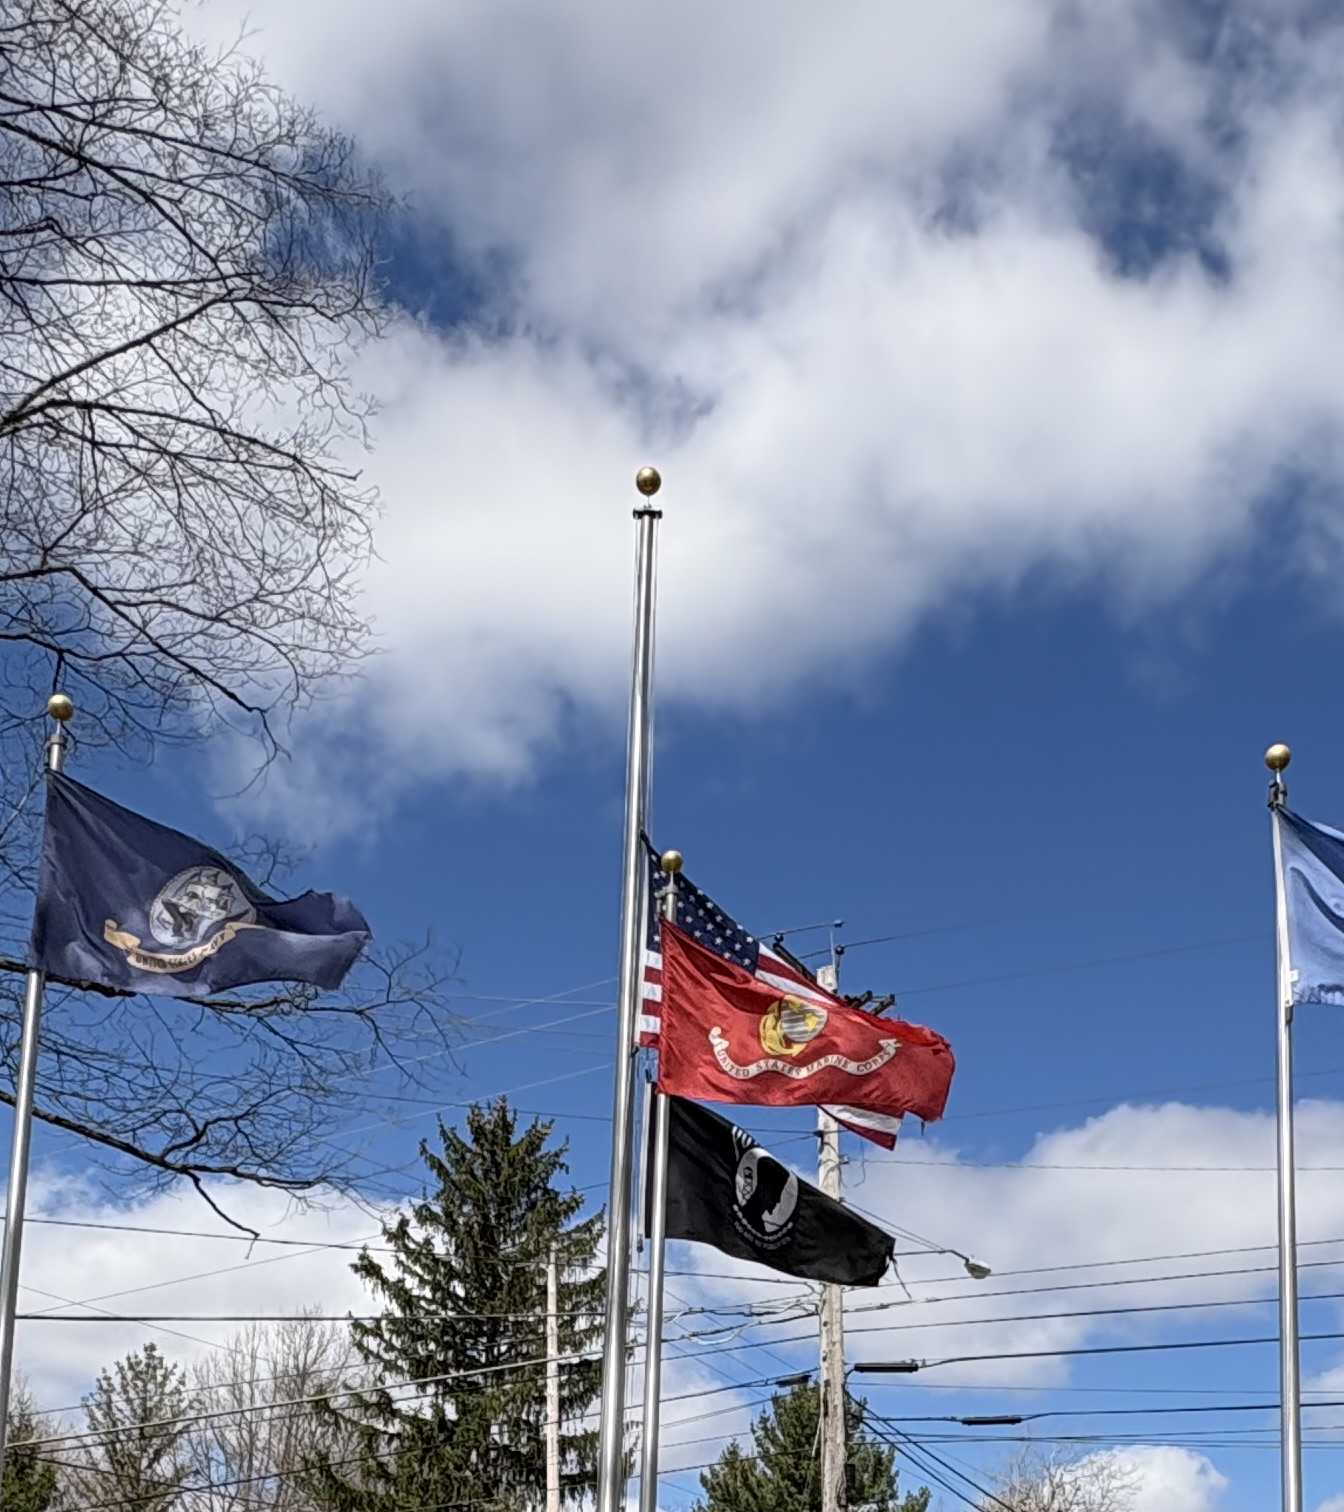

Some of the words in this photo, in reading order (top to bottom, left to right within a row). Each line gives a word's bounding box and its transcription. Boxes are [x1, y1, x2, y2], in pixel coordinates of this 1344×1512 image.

[716, 1049, 750, 1077] UNITED
[756, 1059, 802, 1077] STATES
[806, 1056, 851, 1074] MARINE
[856, 1048, 892, 1073] CORPS
